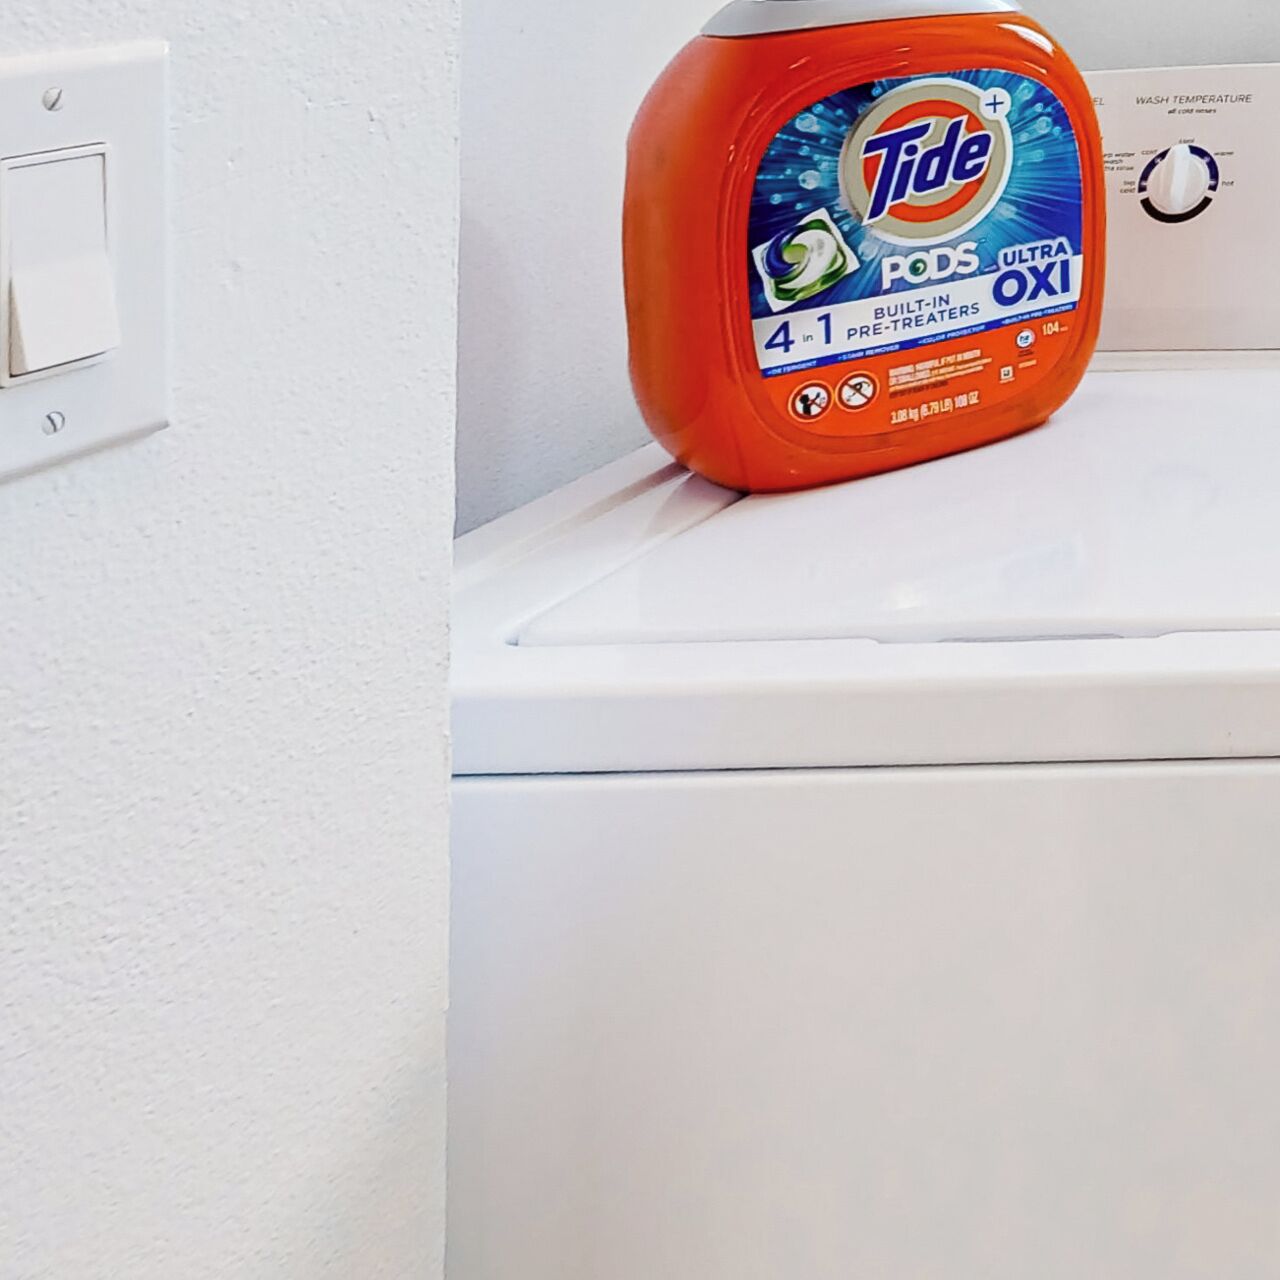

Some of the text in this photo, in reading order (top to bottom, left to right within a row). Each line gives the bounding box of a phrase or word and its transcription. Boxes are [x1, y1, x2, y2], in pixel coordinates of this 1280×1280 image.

[1135, 94, 1253, 105] WASH TEMPERATURE
[862, 115, 993, 225] Tide
[881, 240, 980, 292] PODS
[1002, 241, 1069, 269] ULTRA
[991, 258, 1071, 307] OXI
[847, 303, 981, 341] PRE-TREATERS
[874, 294, 951, 321] BUILT-IN
[763, 312, 832, 354] 4 in 1
[1042, 321, 1059, 336] 104
